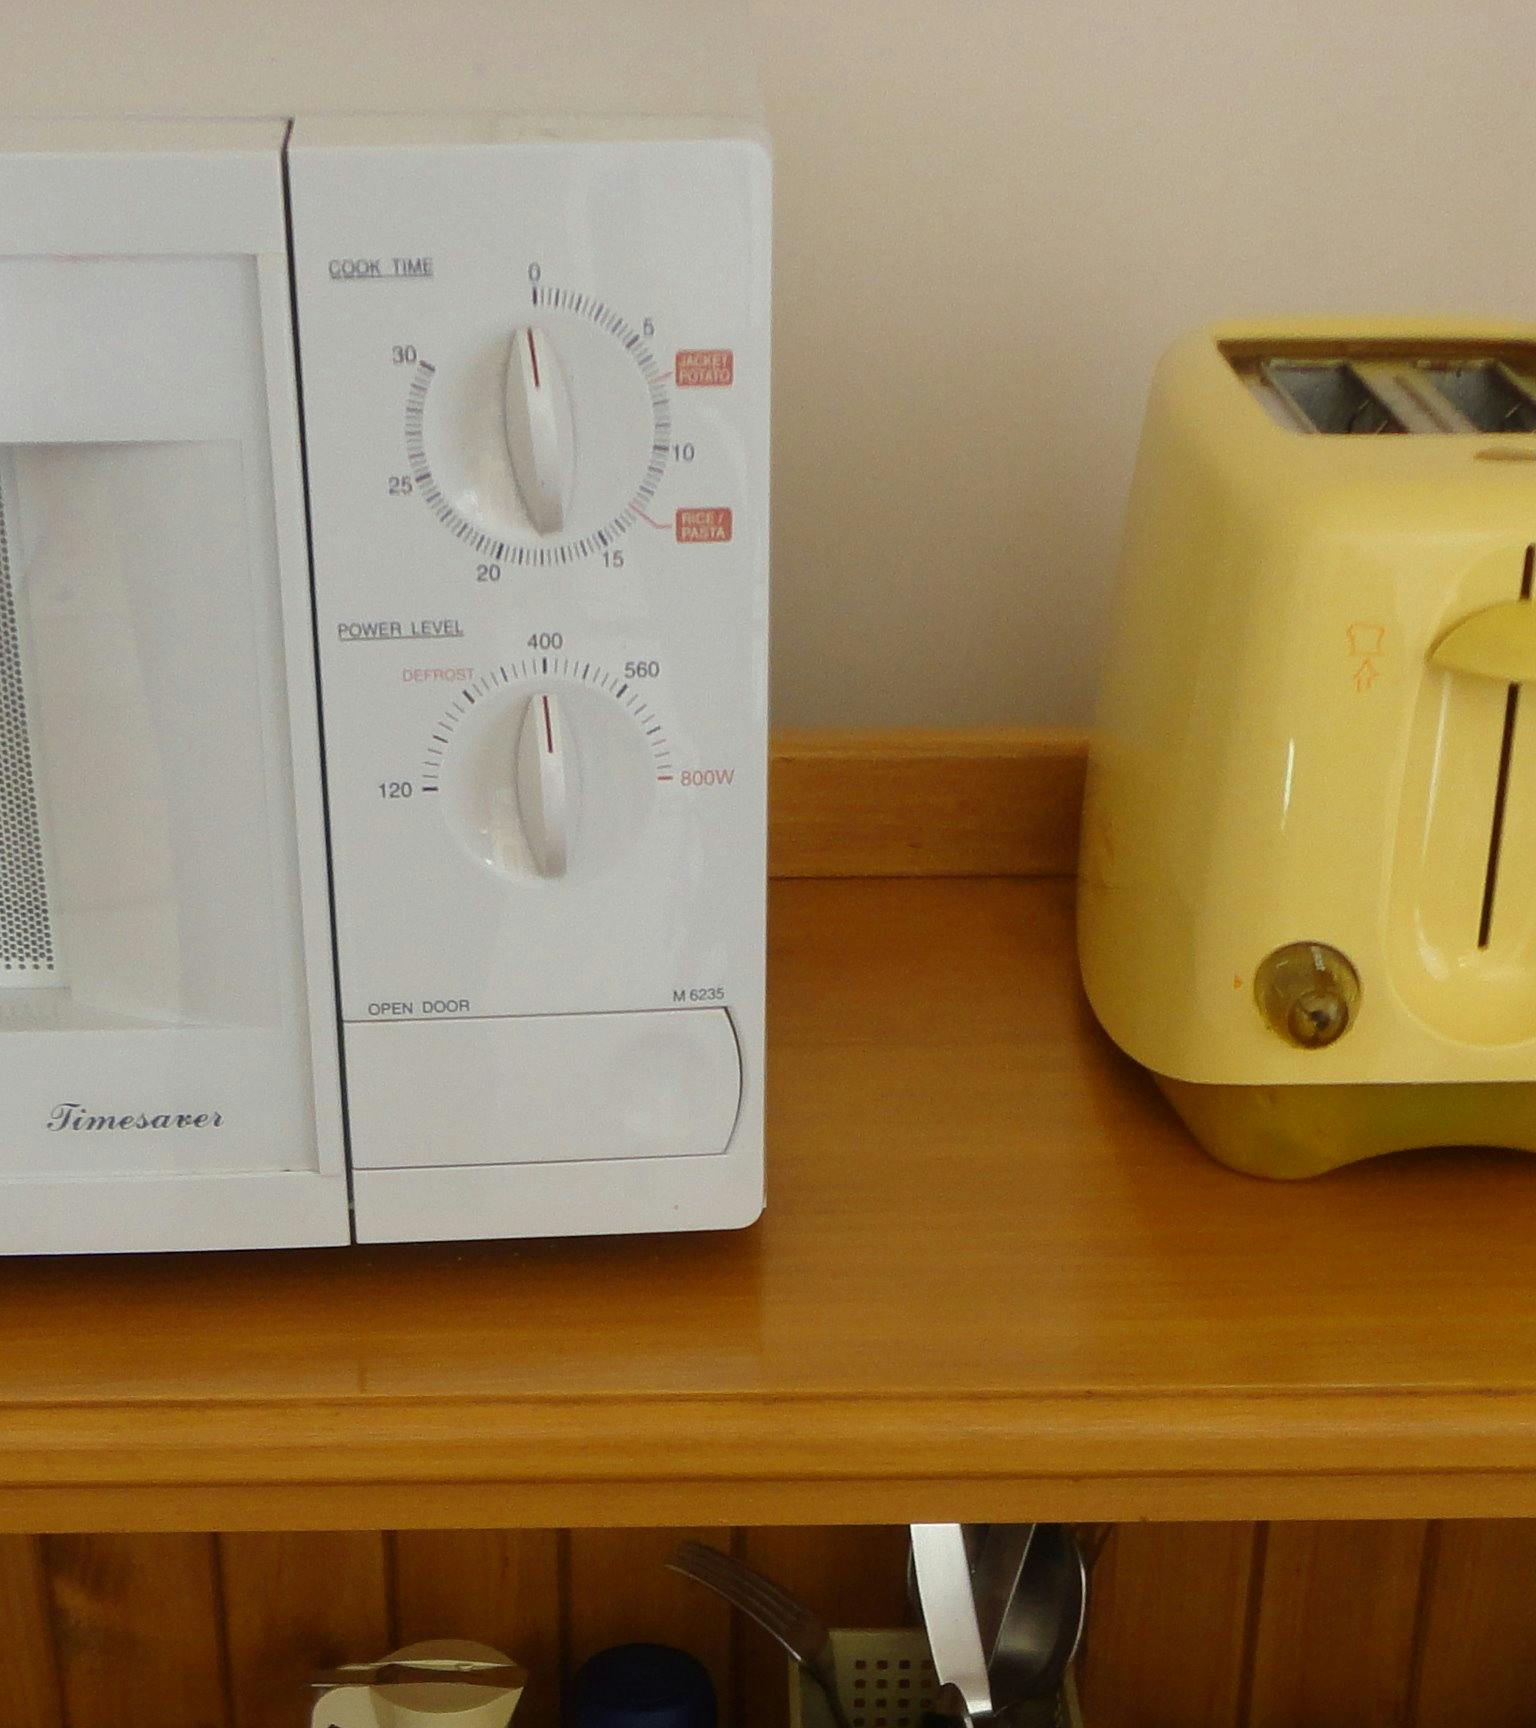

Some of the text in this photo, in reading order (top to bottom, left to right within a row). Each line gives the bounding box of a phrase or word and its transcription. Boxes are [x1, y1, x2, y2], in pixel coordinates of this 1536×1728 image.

[329, 257, 434, 278] COOK TIME
[528, 262, 541, 282] 0
[642, 318, 655, 337] 5
[392, 345, 417, 364] 30
[678, 367, 728, 382] POTATO
[672, 443, 695, 461] 10
[388, 476, 413, 495] 25
[681, 526, 727, 539] PASTA
[602, 551, 624, 568] 15
[476, 565, 501, 582] 20
[338, 619, 464, 639] POWER LEVEL
[527, 632, 563, 650] 400
[402, 667, 474, 683] DEFROST
[624, 660, 660, 679] 560
[680, 769, 734, 787] 800W
[378, 781, 412, 799] 120
[368, 1000, 470, 1016] OPEN DOOR
[46, 1102, 224, 1131] Timesaver
